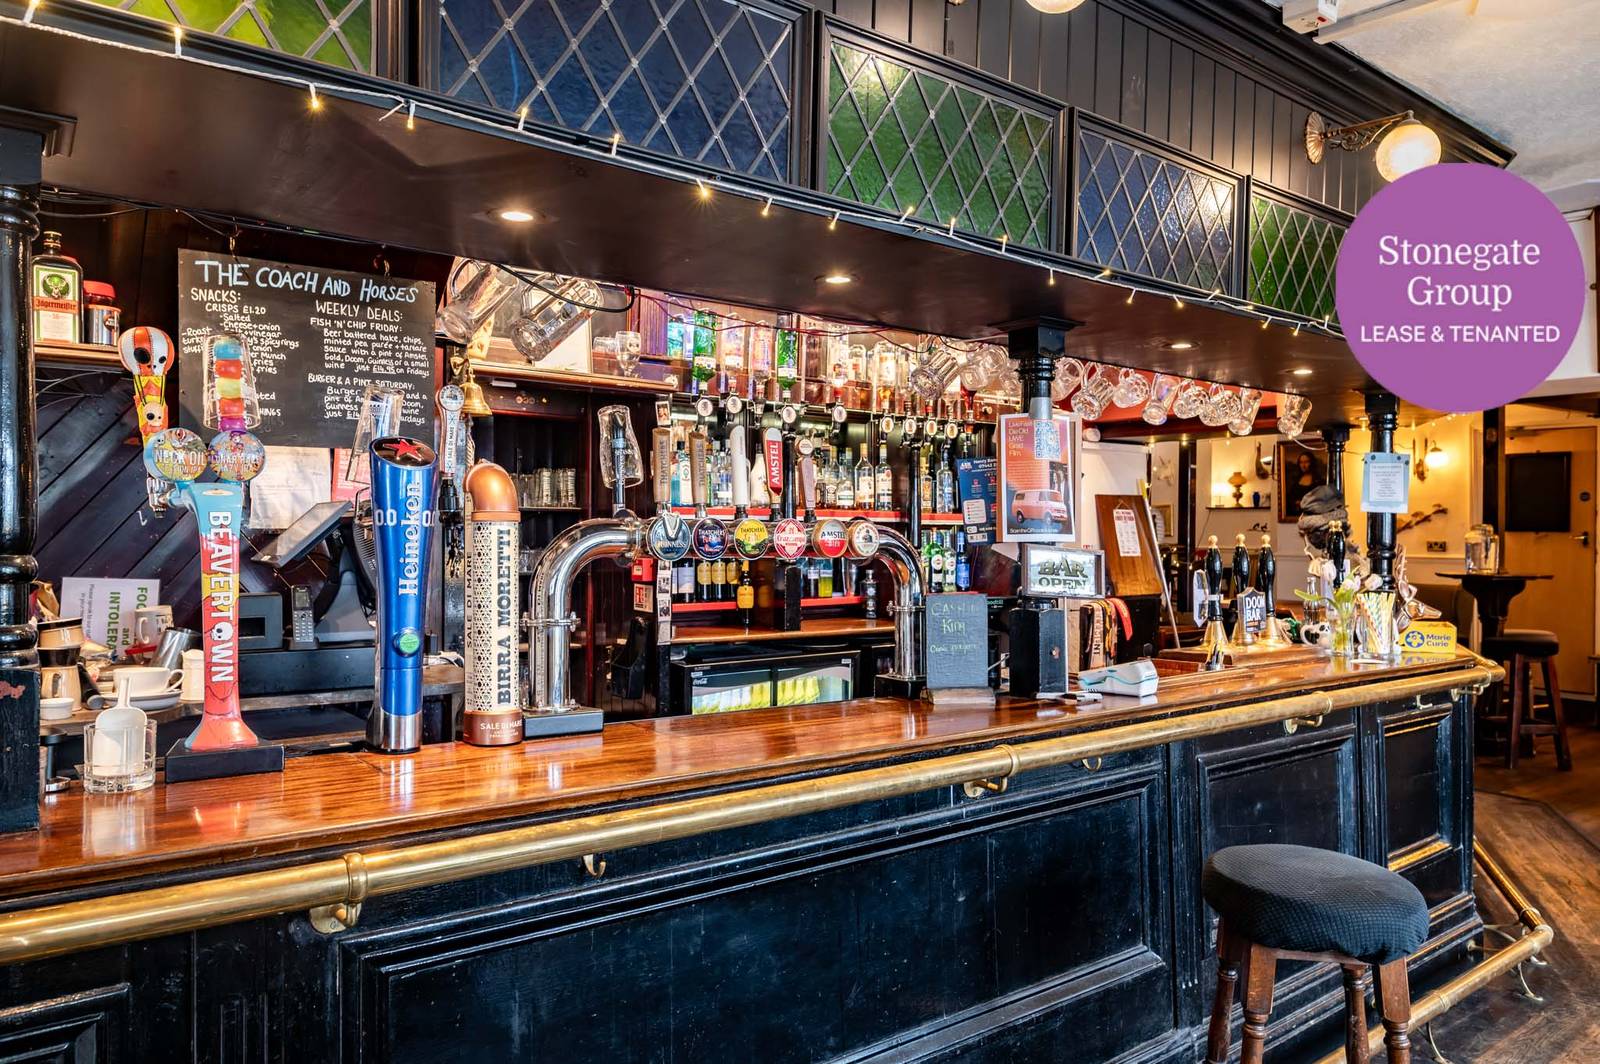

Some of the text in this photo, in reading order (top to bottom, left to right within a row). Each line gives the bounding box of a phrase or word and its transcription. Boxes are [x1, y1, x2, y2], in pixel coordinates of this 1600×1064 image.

[194, 260, 419, 303] THE COACH AND HORSES
[190, 287, 241, 304] SNACKS:
[205, 303, 267, 315] CRISPS £1.20
[315, 299, 403, 322] WEEKLY DEALS:
[310, 317, 332, 327] FISH
[346, 320, 367, 330] CHIP
[370, 322, 403, 333] FRIDAY:
[323, 328, 342, 338] Beer
[344, 329, 377, 340] battered
[403, 335, 425, 346] chips,
[323, 338, 352, 347] minted
[354, 340, 369, 349] pea
[260, 352, 287, 361] Munch
[323, 345, 347, 354] sauce
[351, 346, 369, 356] with
[378, 349, 394, 358] pint
[395, 351, 404, 359] of
[253, 359, 274, 367] fries
[324, 353, 344, 362] Gold,
[344, 354, 367, 364] Doom,
[367, 356, 394, 366] Guinness
[410, 360, 430, 368] small
[256, 366, 278, 374] fries
[354, 363, 371, 373] just
[373, 366, 397, 374] £14.95
[406, 367, 430, 378] Fridays
[307, 373, 336, 384] BURGER
[336, 376, 343, 385] &
[344, 377, 352, 385] A
[375, 380, 416, 391] SATURDAY:
[326, 385, 362, 397] Burger
[324, 395, 341, 404] pint
[343, 395, 352, 403] of
[325, 401, 359, 411] Guinness
[324, 410, 343, 419] just
[400, 415, 426, 426] urdays
[155, 449, 205, 466] NECK OIL
[771, 442, 780, 485] AMSTEL
[375, 509, 397, 527] 0.0
[398, 481, 422, 596] Heineken
[820, 531, 847, 539] AMSTEL
[1038, 556, 1089, 578] BAR
[1038, 576, 1087, 590] OPEN
[467, 598, 473, 609] DI
[1245, 596, 1265, 609] DOOM
[497, 529, 511, 704] BIRRA MORETTI
[1246, 610, 1261, 621] BAR
[122, 627, 130, 646] and
[1426, 633, 1451, 641] Marie
[1426, 640, 1449, 648] Curie
[480, 722, 500, 730] SALE
